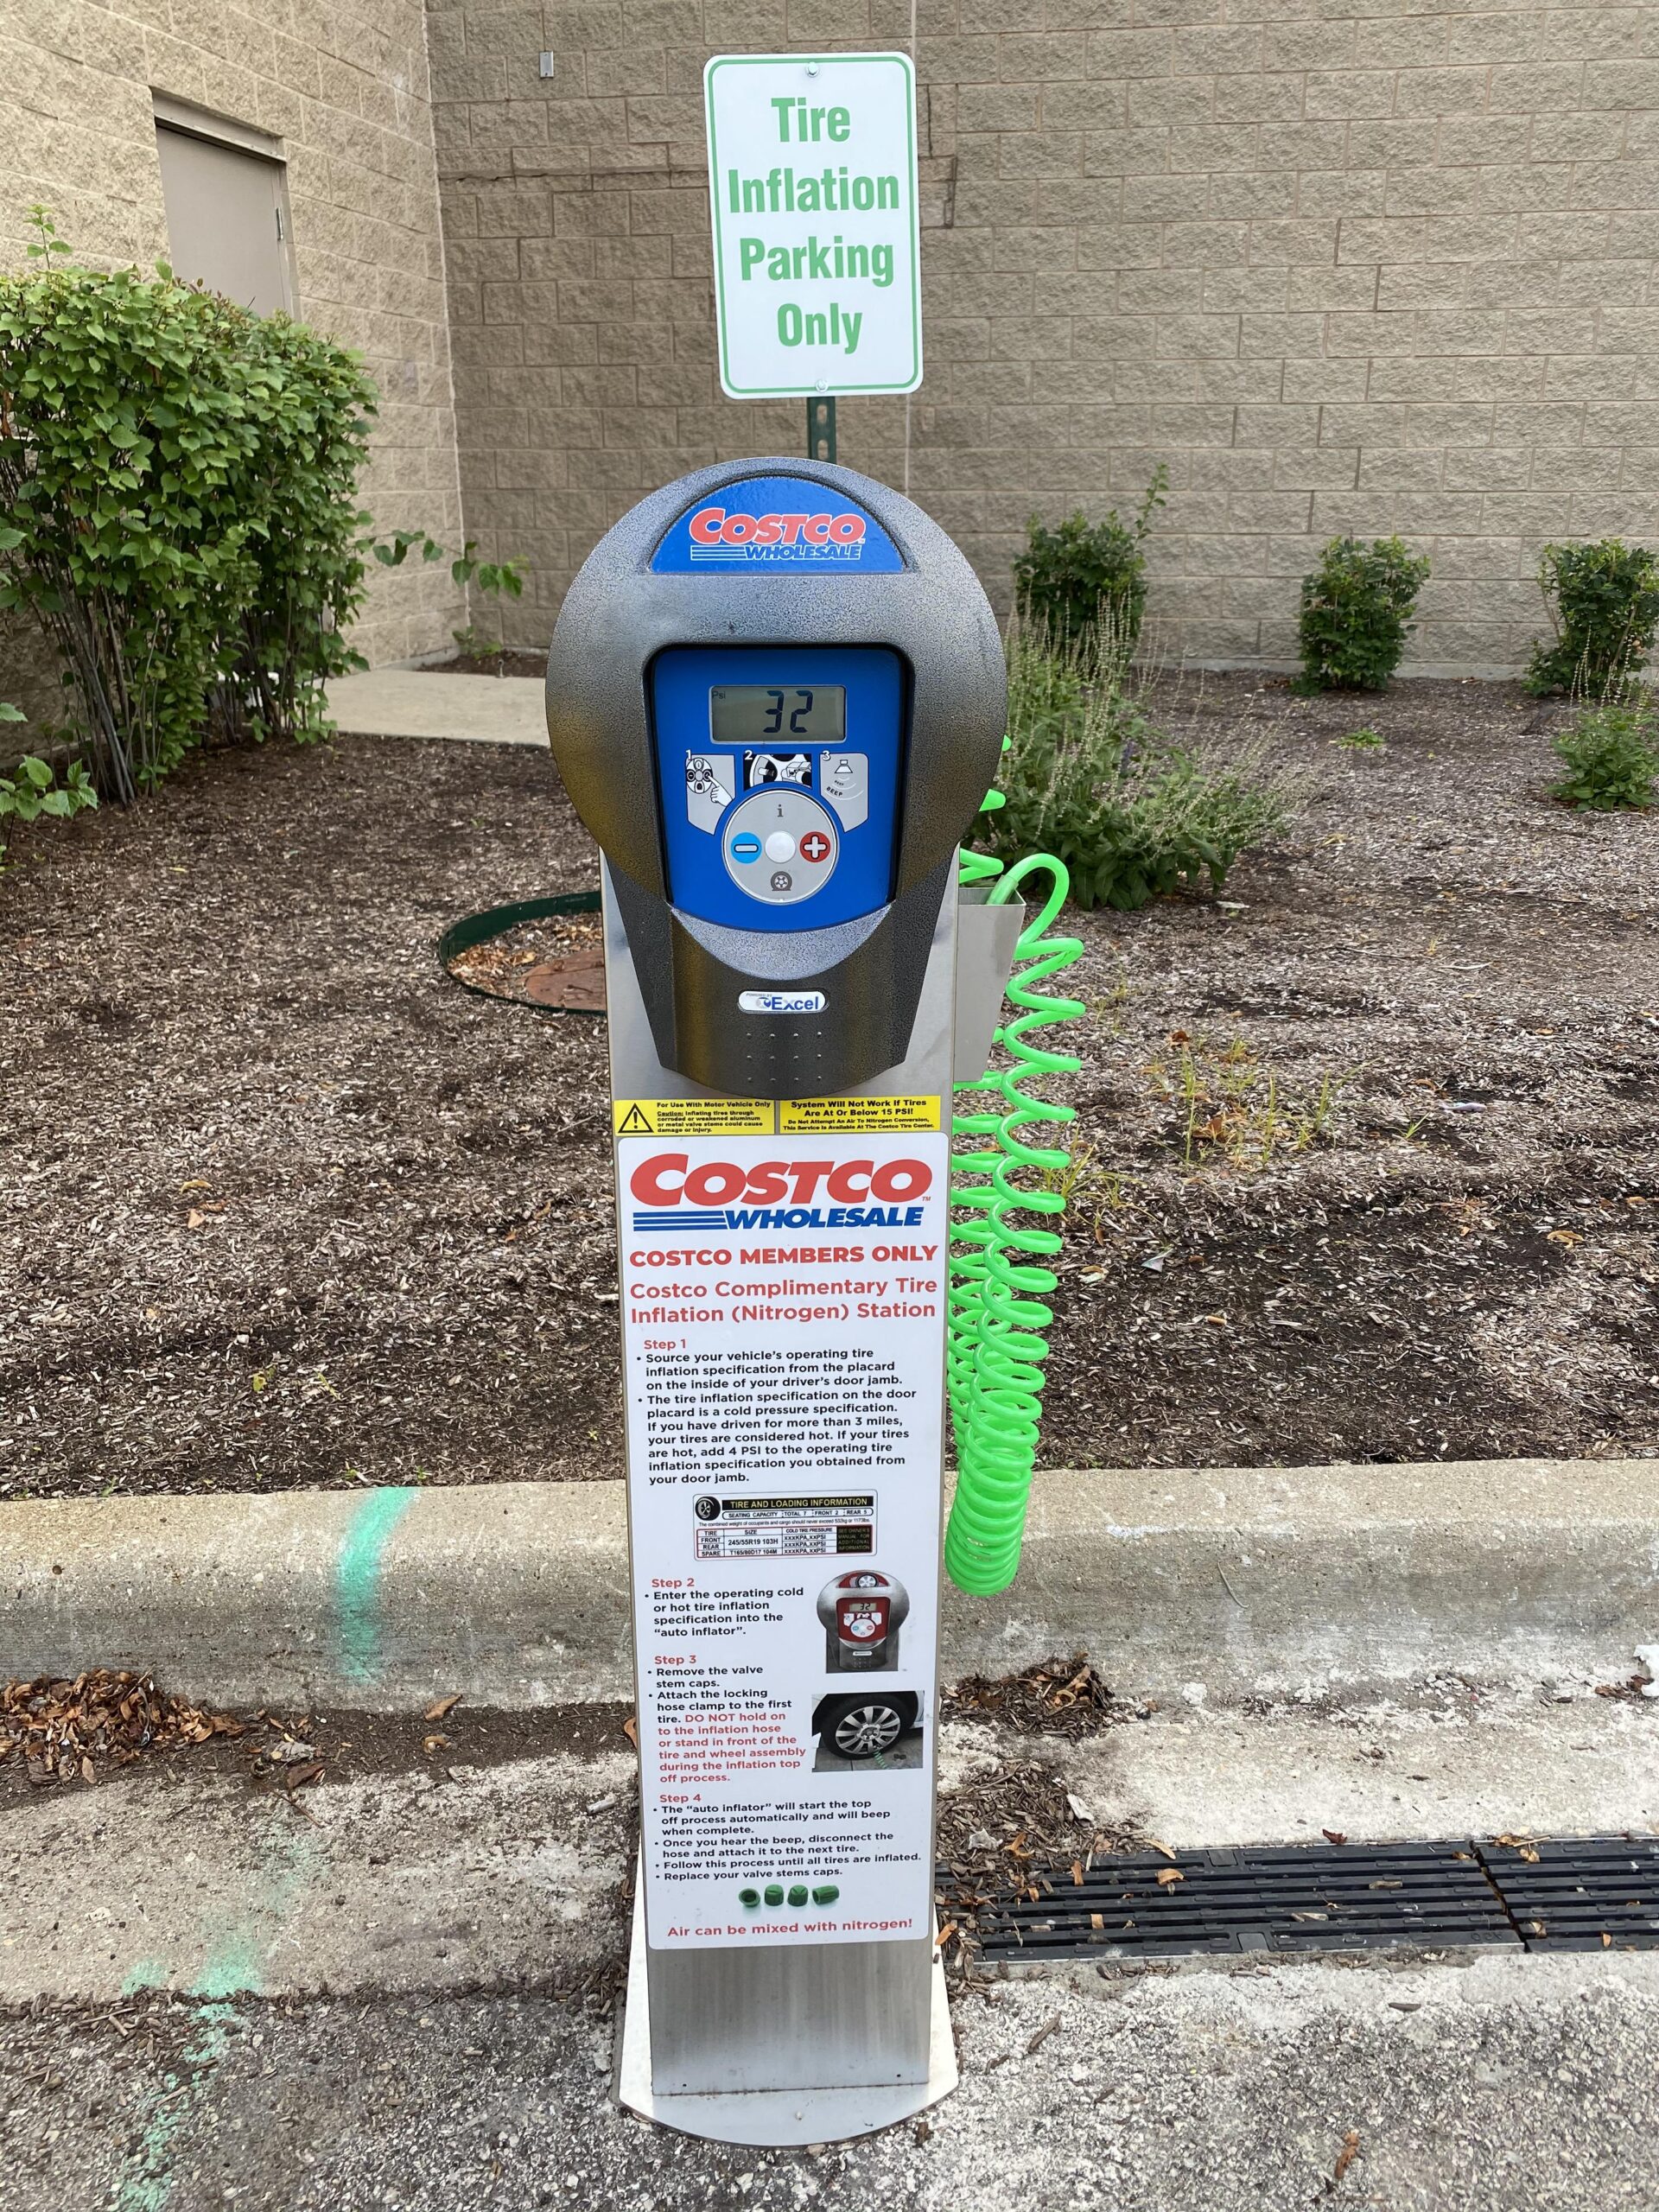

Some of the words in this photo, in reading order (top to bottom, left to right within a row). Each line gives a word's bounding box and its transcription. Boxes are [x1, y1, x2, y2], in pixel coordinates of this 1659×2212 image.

[771, 97, 849, 142] Tire
[728, 166, 899, 213] Inflation
[740, 235, 893, 287] Parking
[777, 302, 861, 353] Only
[690, 508, 866, 544] COSTCO
[745, 545, 861, 560] WHOLESALE
[763, 690, 812, 733] 32
[686, 749, 692, 760] 1
[745, 751, 753, 760] 2
[823, 751, 830, 760] 3
[826, 786, 843, 797] BEEP
[631, 1153, 932, 1206] COSTCO
[724, 1207, 924, 1229] WHOLESALE
[630, 1249, 731, 1267] COSTCO
[741, 1246, 864, 1264] MEMBERS
[872, 1245, 938, 1262] ONLY
[630, 1283, 707, 1298] Costco
[715, 1280, 887, 1298] Complimentary
[895, 1277, 937, 1293] Tire
[632, 1306, 722, 1323] Inflation
[732, 1303, 849, 1323] (Nitrogen)
[857, 1301, 935, 1318] Station
[644, 1339, 676, 1351] Step
[680, 1338, 685, 1348] 1
[646, 1354, 690, 1363] Source
[694, 1354, 722, 1363] your
[786, 1349, 847, 1360] operating
[852, 1349, 873, 1357] tire
[646, 1366, 698, 1376] inflation
[702, 1364, 784, 1376] specification
[789, 1363, 818, 1372] from
[823, 1363, 842, 1371] the
[848, 1362, 894, 1372] placard
[666, 1380, 686, 1389] the
[691, 1379, 728, 1389] inside
[733, 1378, 746, 1387] of
[750, 1380, 778, 1389] your
[868, 1375, 902, 1386] jamb.
[652, 1579, 682, 1588] Step
[687, 1578, 694, 1586] 2
[690, 1590, 709, 1599] the
[714, 1588, 772, 1599] operating
[777, 1587, 803, 1596] cold
[719, 1601, 769, 1610] inflation
[654, 1615, 731, 1625] specification
[654, 1656, 684, 1665] Step
[690, 1655, 696, 1663] 3
[660, 1794, 688, 1803] Step
[874, 1853, 920, 1861] inflated.
[664, 1872, 709, 1881] Replace
[667, 1927, 690, 1936] Air
[728, 1925, 746, 1934] be
[752, 1923, 798, 1933] mixed
[804, 1922, 836, 1931] with
[842, 1918, 912, 1930] nitrogen!
